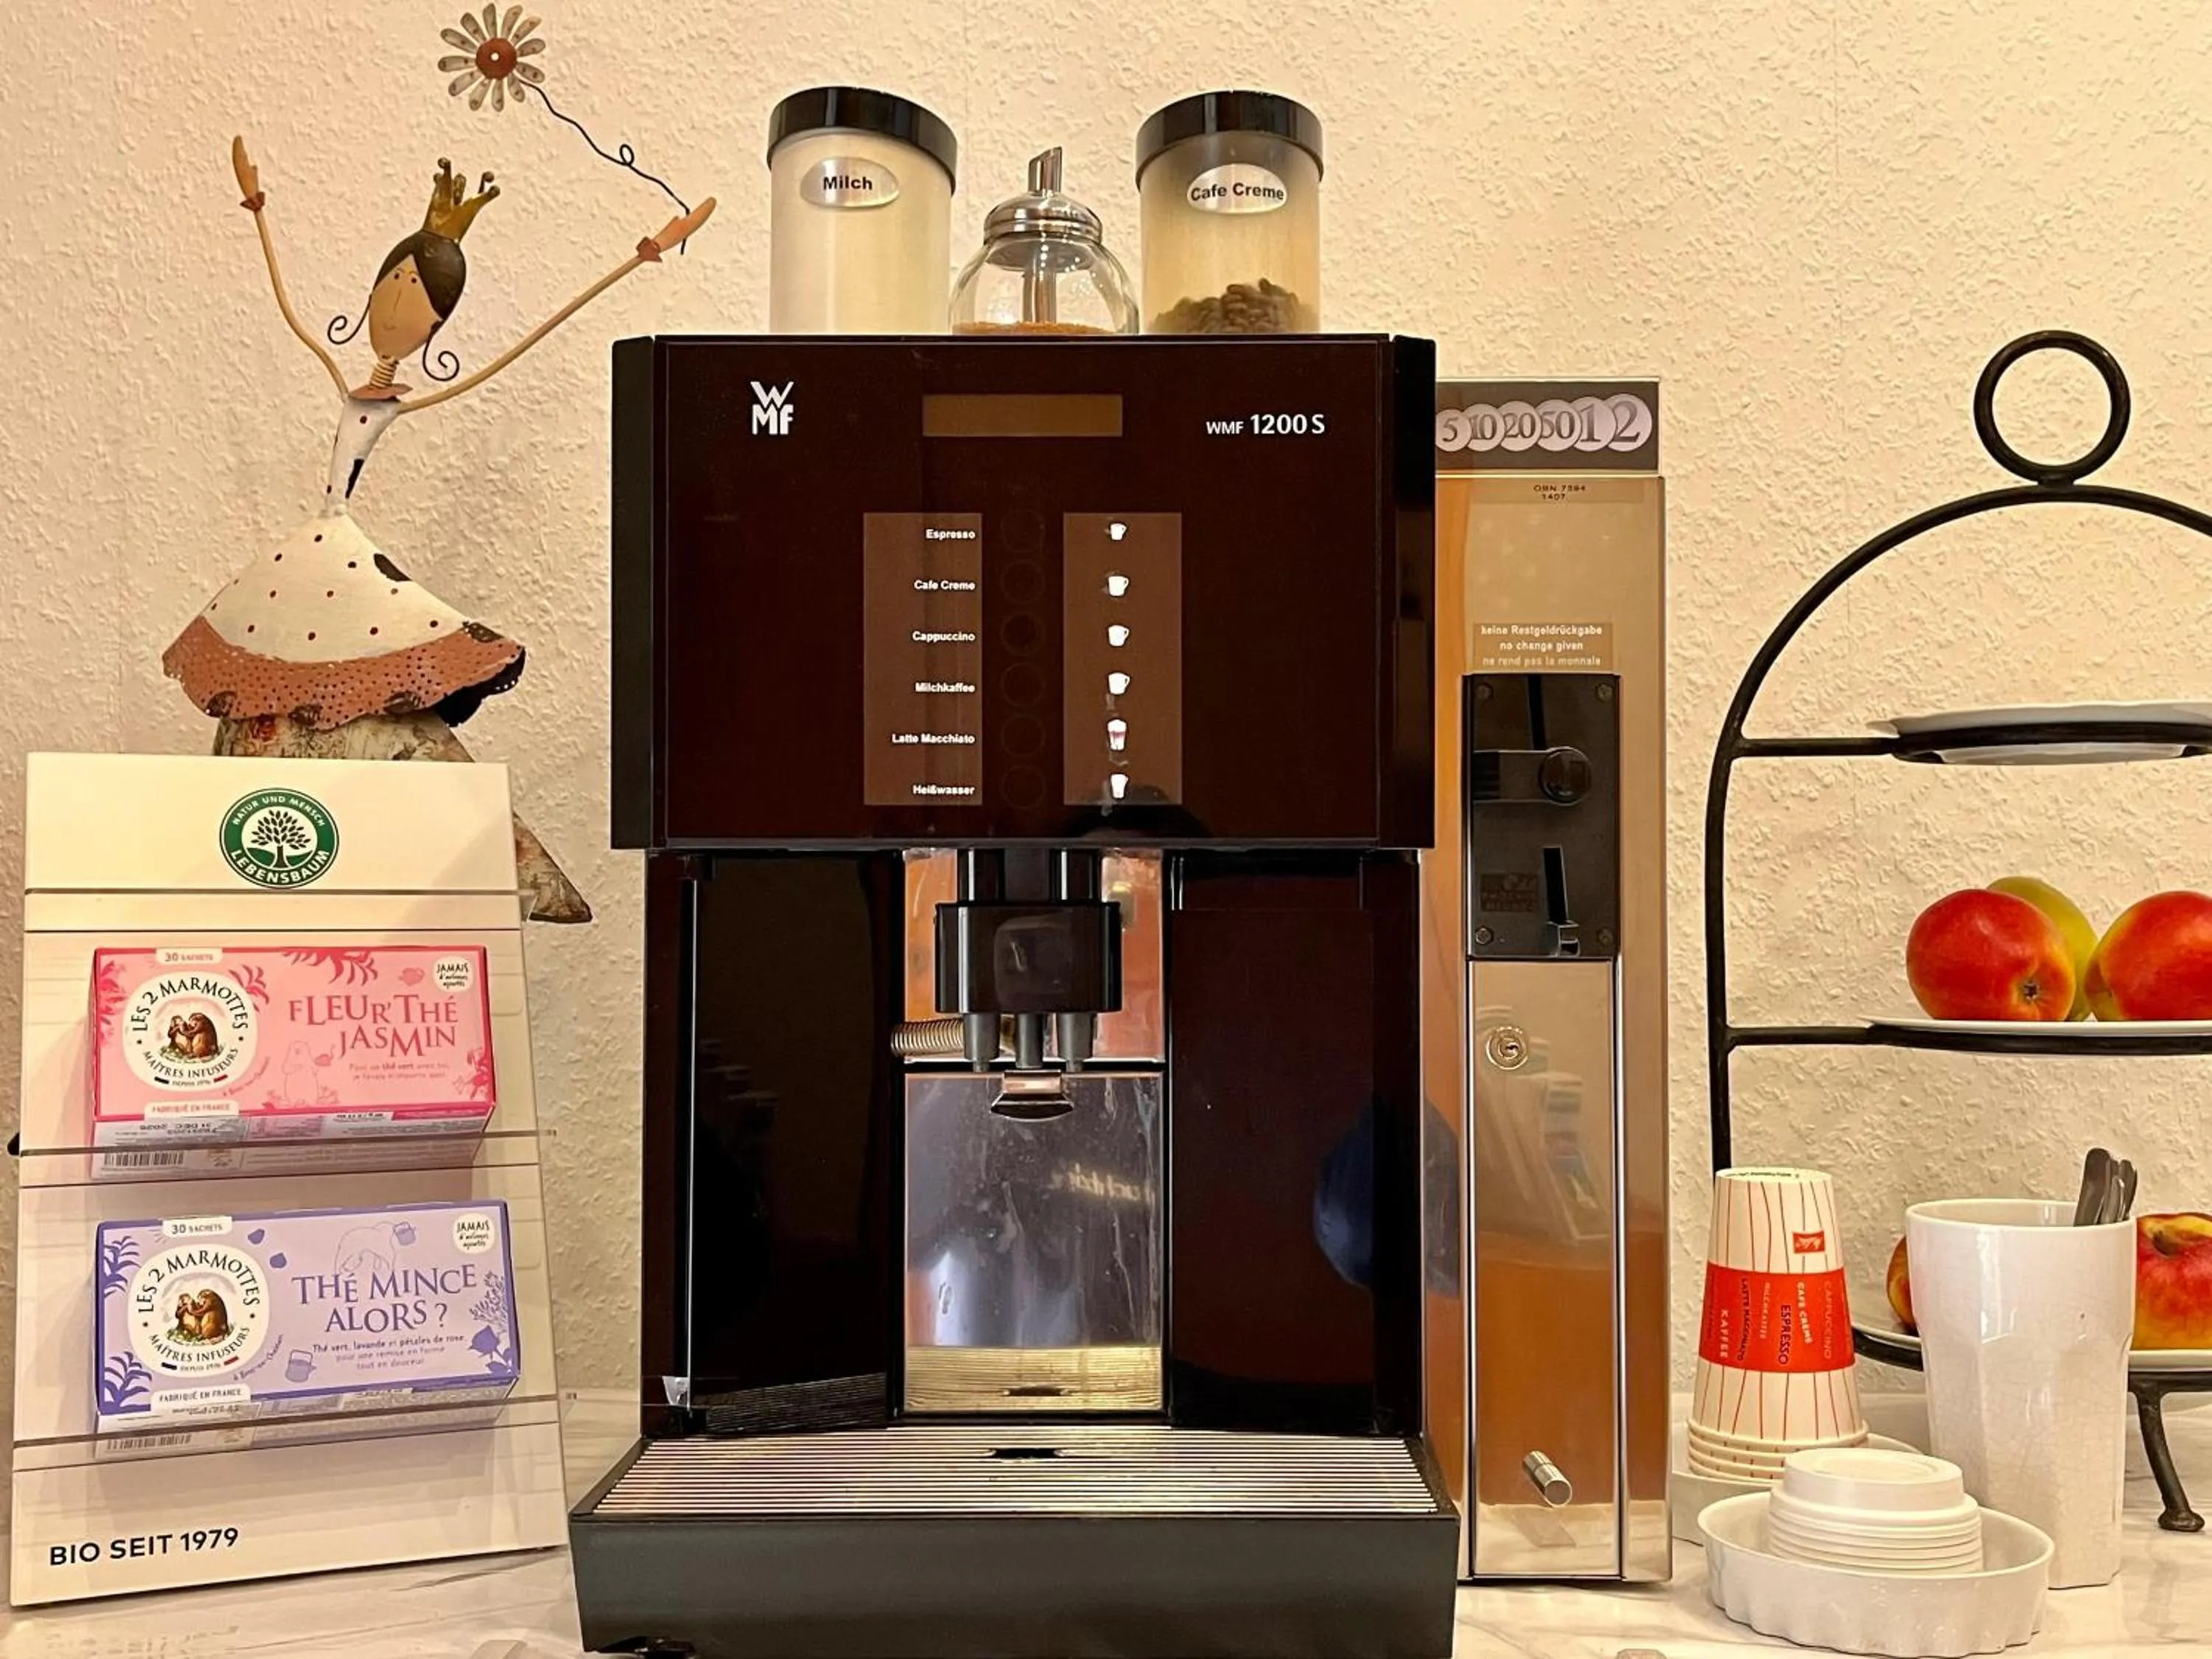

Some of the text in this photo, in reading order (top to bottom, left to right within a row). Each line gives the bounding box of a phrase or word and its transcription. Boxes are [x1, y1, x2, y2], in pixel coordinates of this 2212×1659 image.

[823, 175, 873, 190] Milch
[1190, 182, 1284, 201] Cafe Creme
[1206, 414, 1326, 434] WMF 1200 S
[1442, 417, 1459, 442] 5
[1505, 412, 1537, 439] 20
[1580, 403, 1601, 442] 1
[1611, 400, 1640, 442] 2
[926, 529, 975, 540] Espresso
[914, 580, 975, 591] Cafe Creme
[912, 631, 975, 644] Cappuccino
[1481, 625, 1602, 637] keine Restgeldrückgabe
[1500, 641, 1583, 653] no change given
[915, 683, 975, 693] Milchkaffee
[891, 733, 975, 744] Latte Macchiato
[913, 784, 975, 795] Heißwasser
[232, 796, 326, 827] NATUR UND MENSCH
[230, 849, 331, 884] LEBENSBAUM
[437, 962, 469, 973] JAMAIS
[131, 977, 249, 1032] LES 2 MARMOTTES
[340, 1026, 456, 1058] JASMIN
[187, 1047, 239, 1078] INFUSEURS
[172, 1224, 187, 1234] 30
[457, 1220, 490, 1233] JAMAIS
[136, 1250, 260, 1313] LES 2 MARMOTTES
[292, 1263, 478, 1304] THÉ MINCE
[1720, 1309, 1729, 1357] KAFFEE
[1778, 1304, 1792, 1365] ESPRESSO
[196, 1326, 250, 1363] INFUSEURS
[50, 1527, 238, 1565] BIO SEIT 1979
